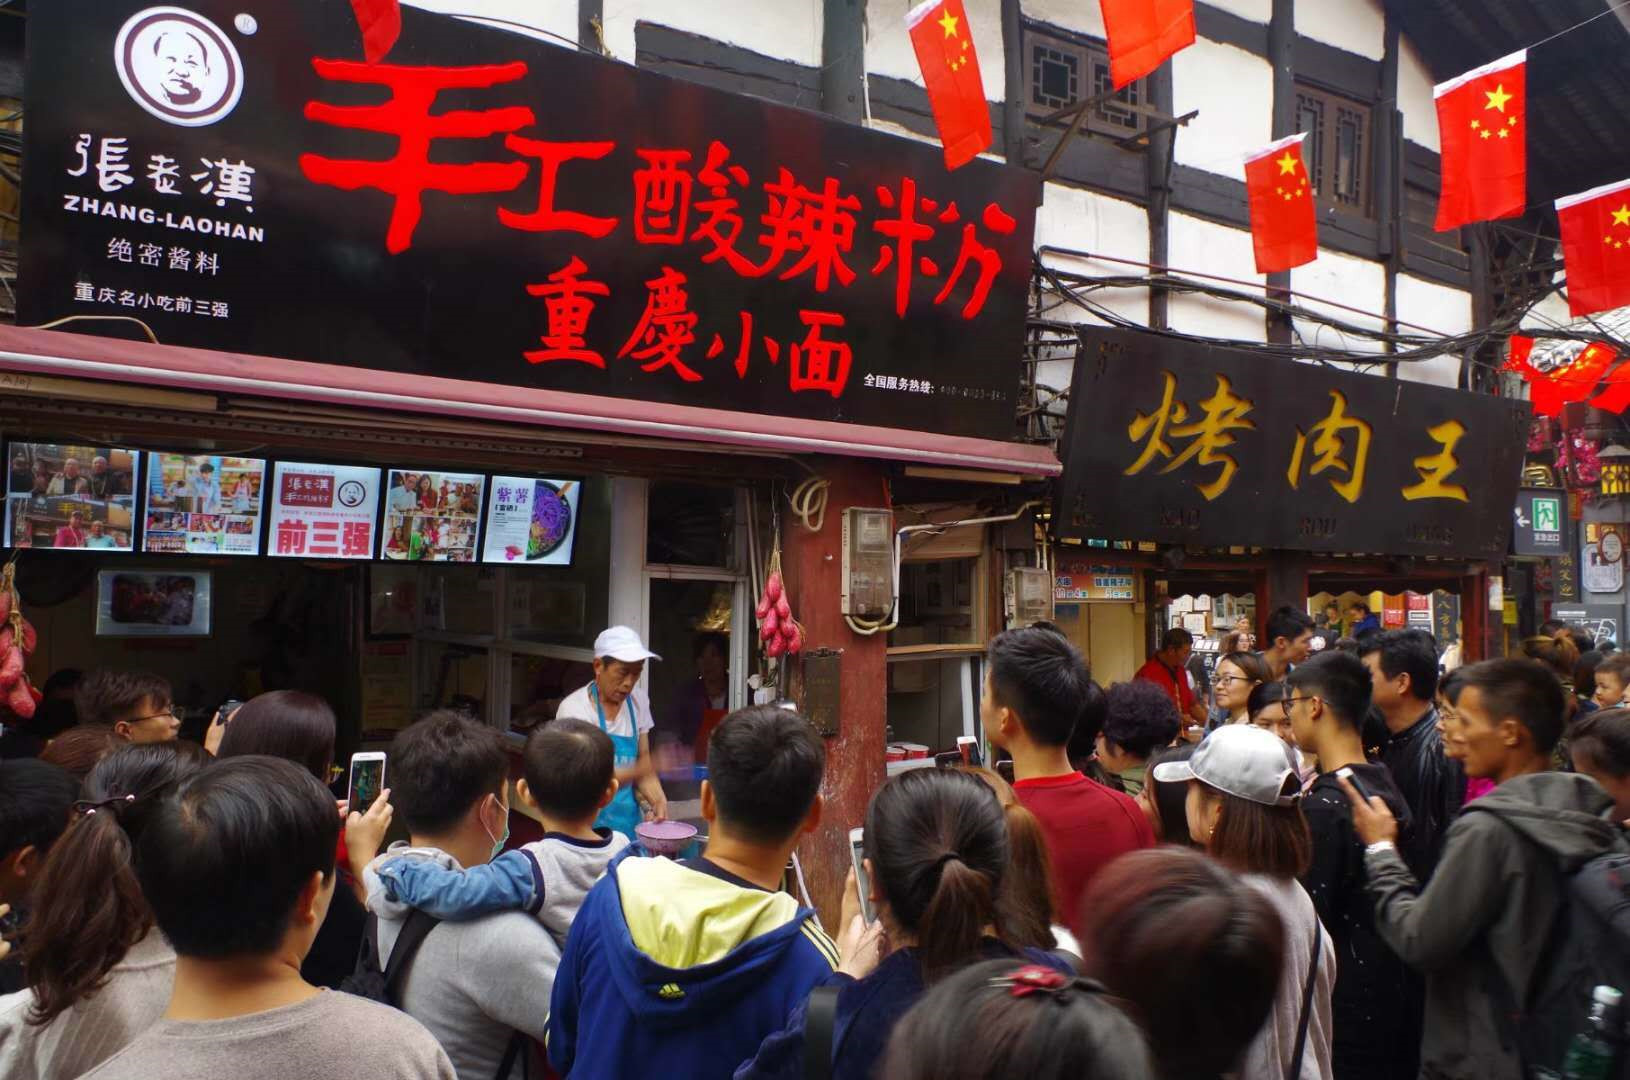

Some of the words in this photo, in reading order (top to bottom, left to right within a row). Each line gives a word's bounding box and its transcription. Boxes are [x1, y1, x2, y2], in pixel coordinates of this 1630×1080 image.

[63, 194, 264, 243] ZHANG-LAOHAN
[107, 237, 219, 276] 绝密酱料
[74, 281, 230, 319] 重庆名小吃前三强
[1122, 369, 1470, 504] 烤肉王
[276, 518, 371, 556] 前三强
